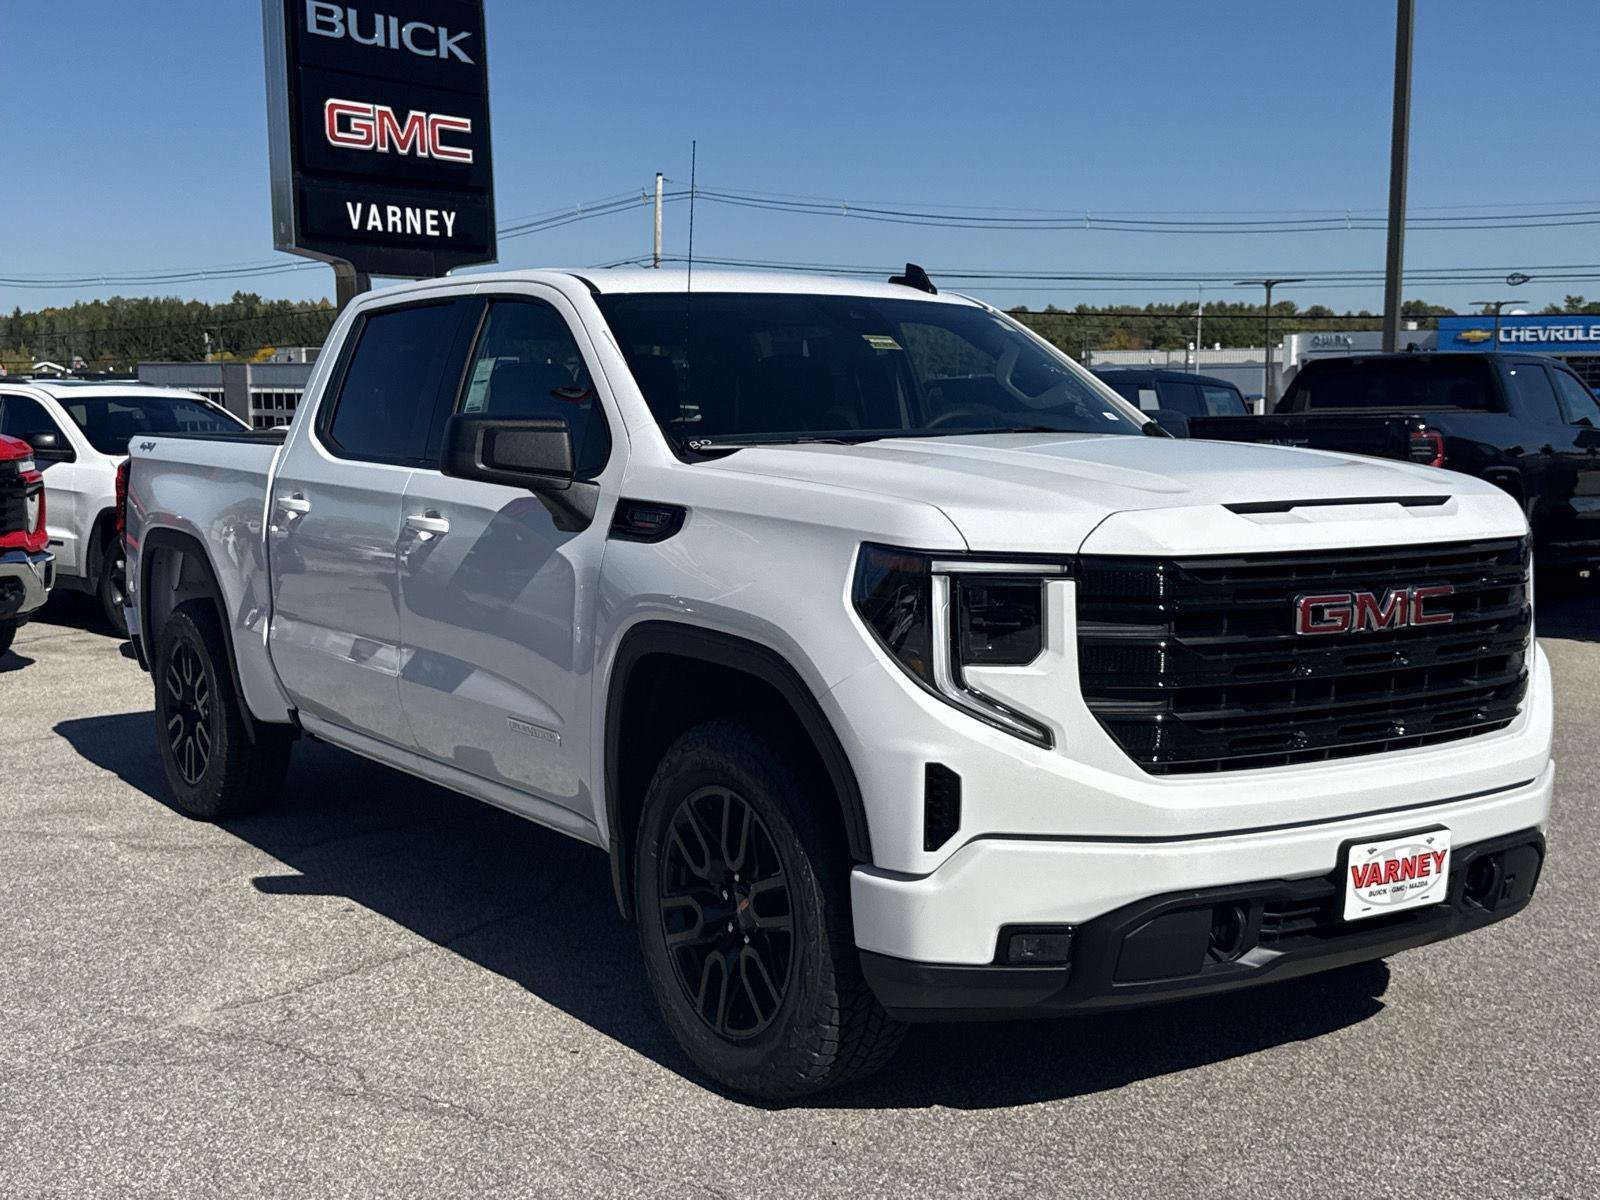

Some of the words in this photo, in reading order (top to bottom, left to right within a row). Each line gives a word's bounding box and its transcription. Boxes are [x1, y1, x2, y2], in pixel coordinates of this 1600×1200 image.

[305, 0, 476, 65] BUICK
[325, 98, 474, 163] GMC
[346, 202, 457, 237] VARNEY
[1294, 584, 1455, 635] GMC
[1351, 849, 1448, 889] VARNEY
[1368, 888, 1387, 897] BUICK
[1391, 885, 1405, 893] GMC
[1409, 880, 1428, 889] MAZDA
